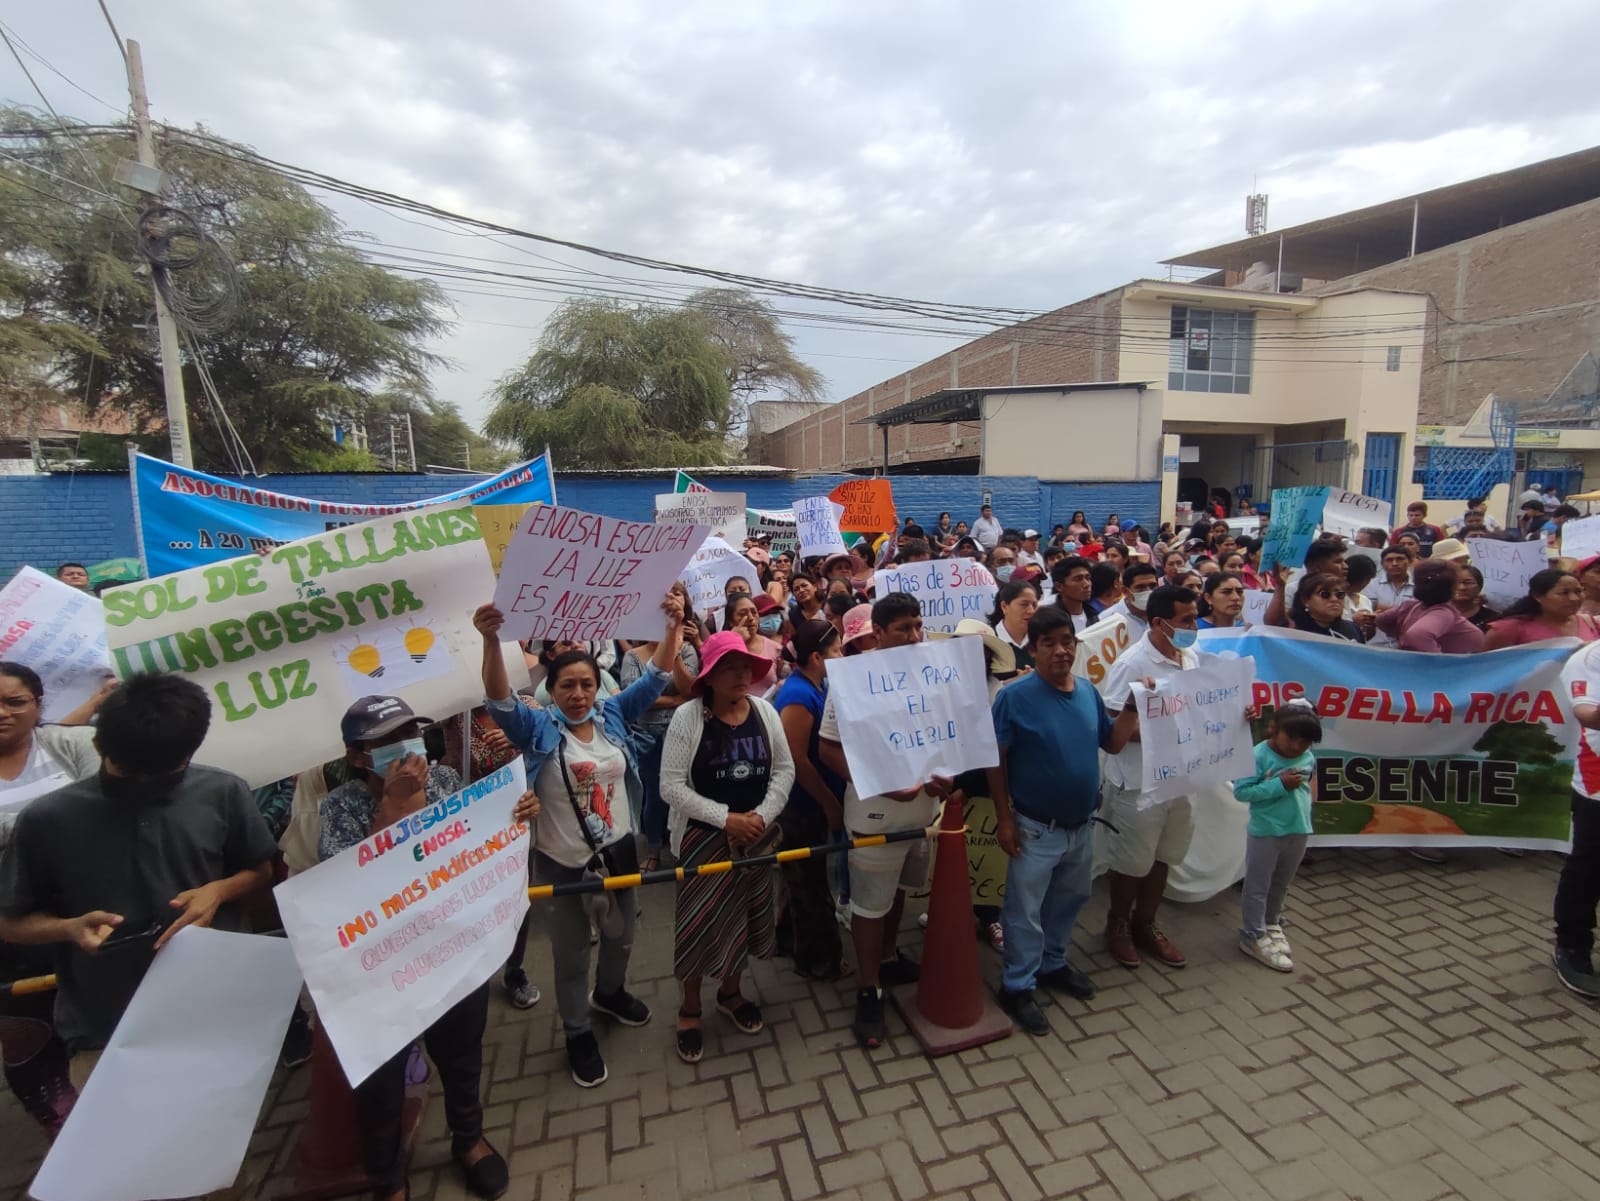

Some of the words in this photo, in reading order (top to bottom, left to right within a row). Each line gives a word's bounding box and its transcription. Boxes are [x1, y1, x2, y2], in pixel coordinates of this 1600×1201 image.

[160, 471, 311, 513] ASOCIACION
[199, 529, 214, 548] A
[216, 532, 244, 549] 20
[528, 505, 603, 549] ENOSA
[606, 521, 695, 554] ESCUCHA
[102, 577, 199, 626] SOL
[203, 557, 267, 603] DE
[272, 506, 484, 583] TALLANES
[542, 548, 580, 582] LA
[585, 556, 642, 588] LUZ
[926, 564, 944, 590] de
[949, 563, 963, 588] 3
[510, 583, 549, 613] ES
[551, 590, 641, 621] NUESTRO
[961, 594, 984, 617] por
[174, 579, 424, 673] NECESITA
[528, 614, 621, 642] DERECHO
[214, 659, 318, 722] LUZ
[868, 670, 907, 695] LUZ
[906, 694, 932, 715] EL
[1317, 686, 1454, 724] BELLA
[1464, 690, 1565, 725] RICA
[889, 720, 957, 751] PUEBLO
[361, 892, 464, 971] QUEREMOS
